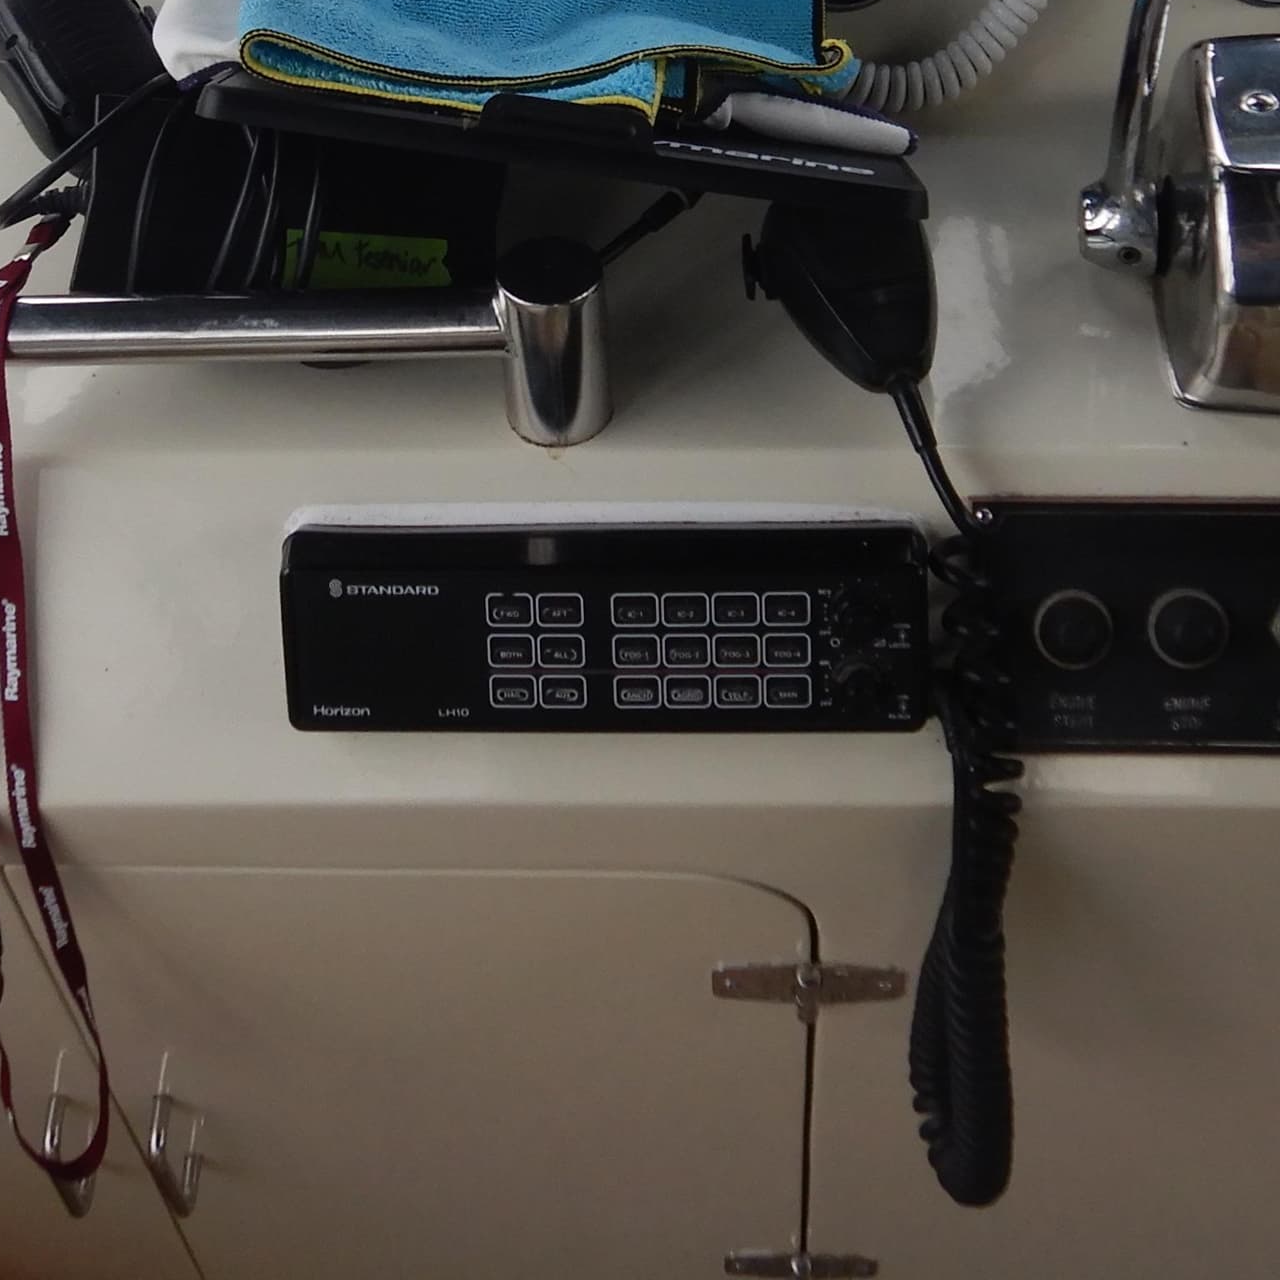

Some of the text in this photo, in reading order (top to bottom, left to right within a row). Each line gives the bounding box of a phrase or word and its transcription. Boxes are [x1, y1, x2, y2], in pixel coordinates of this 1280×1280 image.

[346, 585, 440, 596] STANDARD
[1, 597, 21, 702] Raymarine
[312, 704, 371, 717] Horizon
[437, 708, 470, 718] LH10
[10, 762, 37, 849] Raymarine
